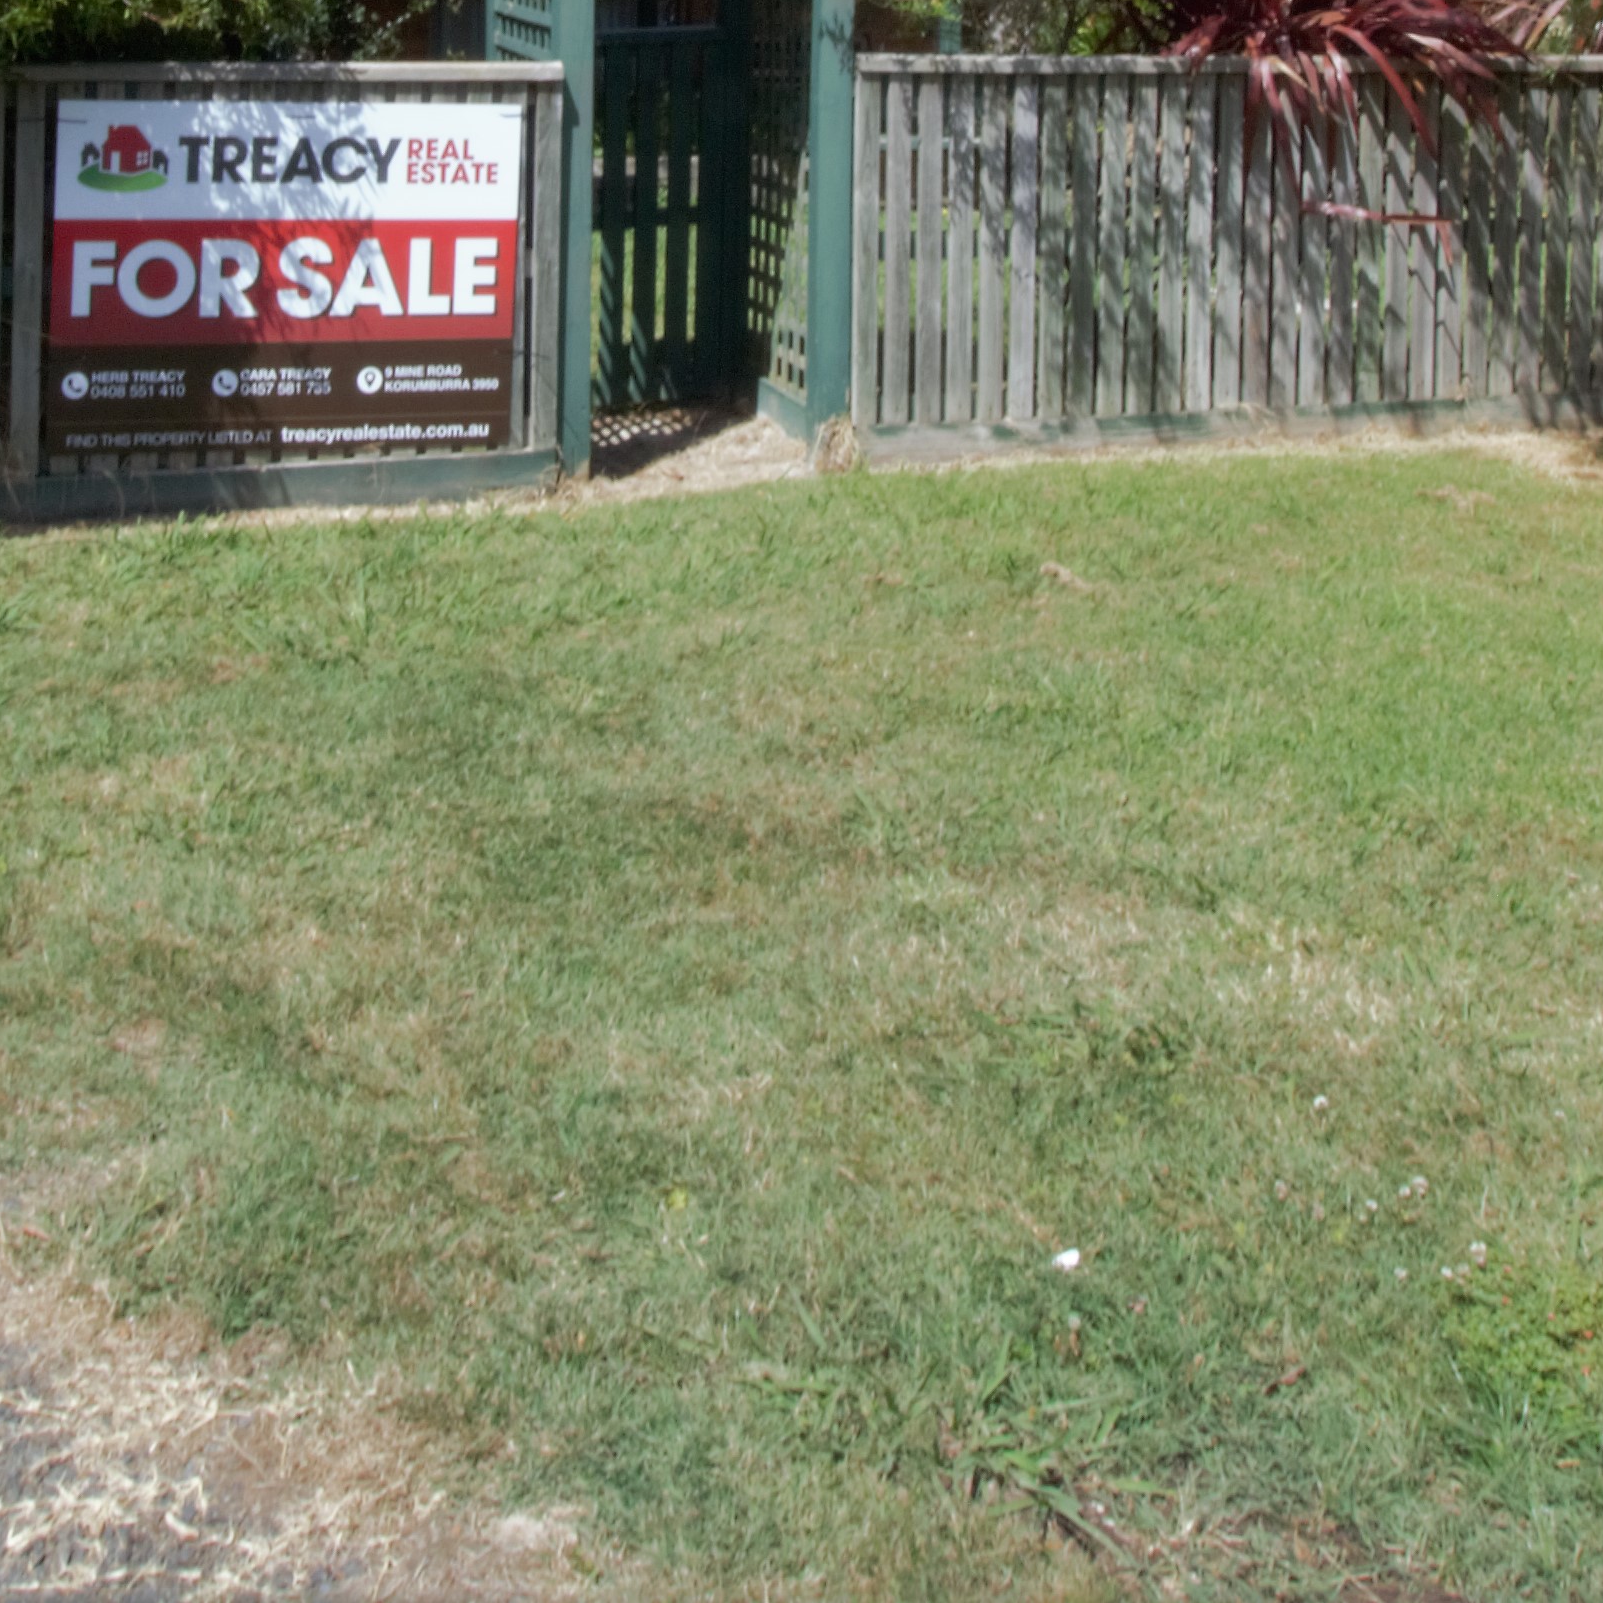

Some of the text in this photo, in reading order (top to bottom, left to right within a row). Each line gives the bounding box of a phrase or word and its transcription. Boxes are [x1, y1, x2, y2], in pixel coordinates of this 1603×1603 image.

[179, 135, 402, 184] TREACY
[407, 139, 475, 160] REAL
[406, 162, 499, 184] ESTATE
[70, 236, 499, 319] FOR SALE
[132, 369, 186, 383] TREACY
[240, 367, 333, 381] CARA TREACY
[394, 365, 424, 378] MINE
[427, 364, 462, 377] ROAD
[384, 378, 471, 393] KORUMBURRA
[66, 424, 490, 446] FIND THIS PROPERTY LISTED AT treacyrealestate.com.au
